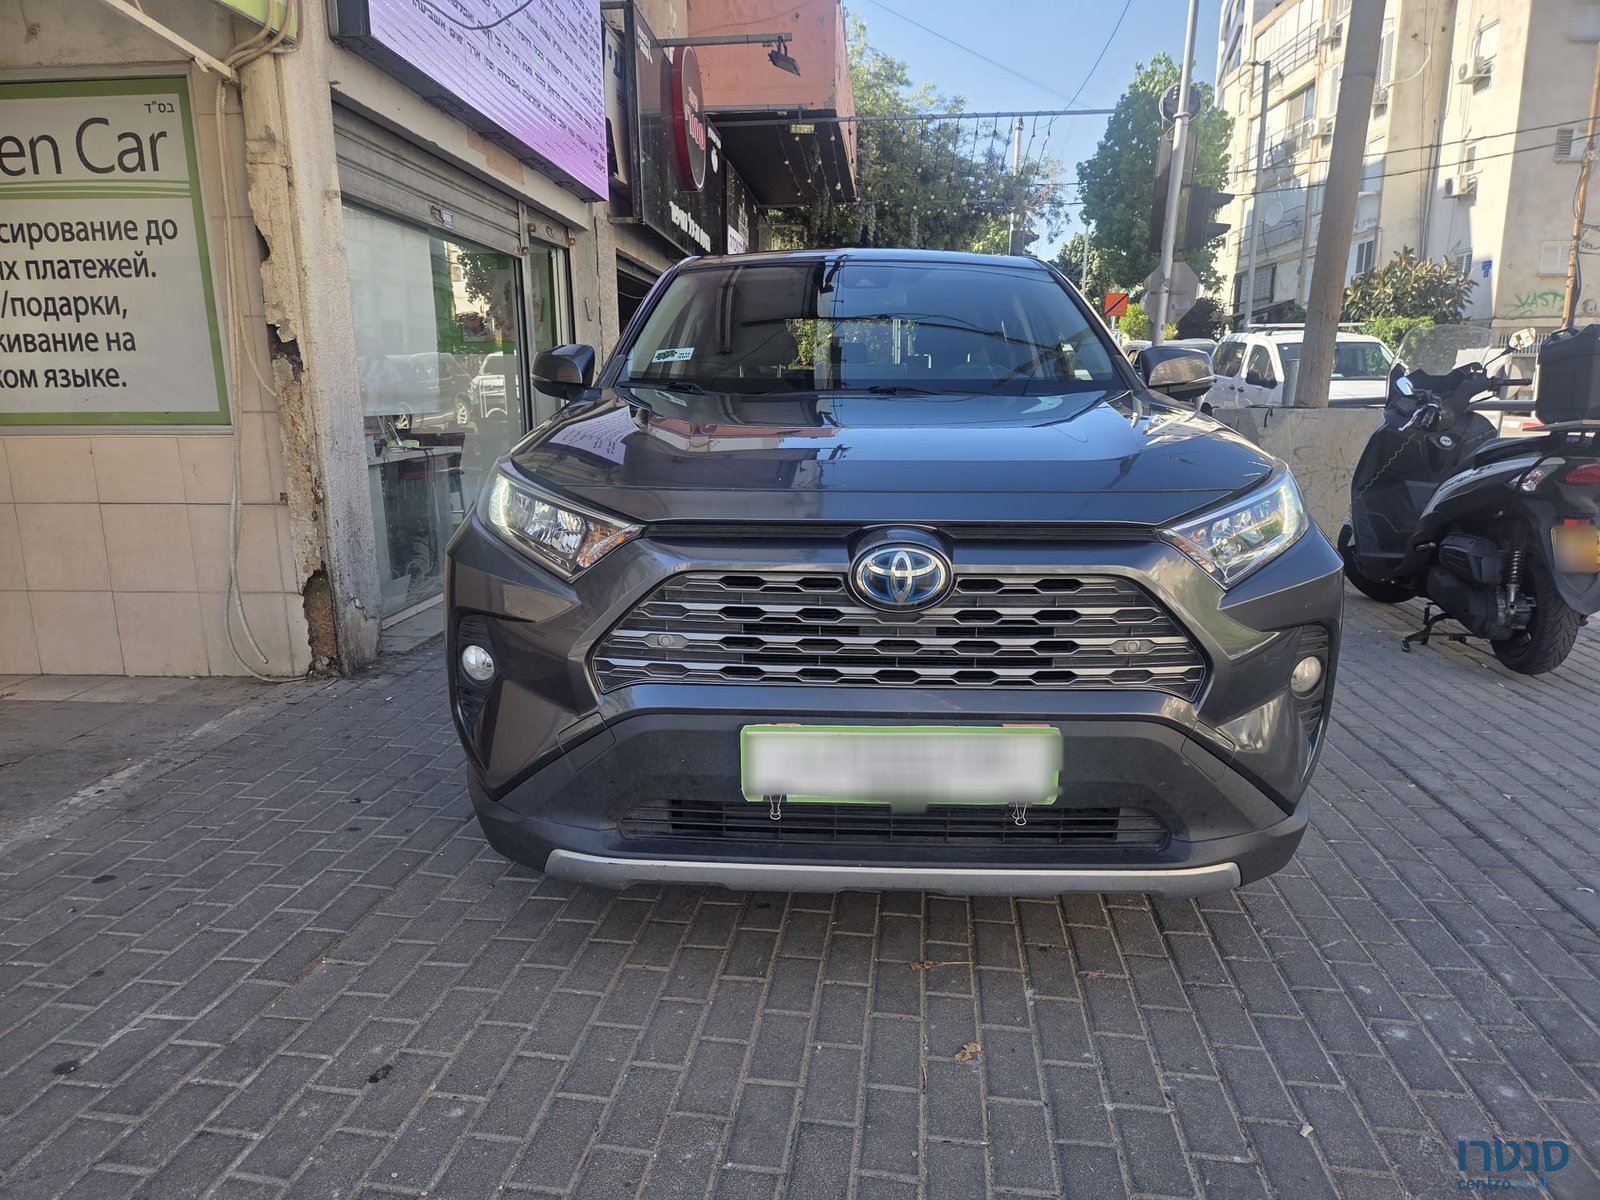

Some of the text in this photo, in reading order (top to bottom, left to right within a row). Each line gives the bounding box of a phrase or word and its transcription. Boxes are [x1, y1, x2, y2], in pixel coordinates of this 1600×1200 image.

[144, 100, 175, 114] בס"ד
[0, 117, 168, 177] en Car
[0, 218, 178, 250] сирование до
[25, 250, 157, 280] платежей.
[1, 290, 128, 323] /подарки,
[106, 331, 136, 352] на
[44, 366, 127, 389] языке.
